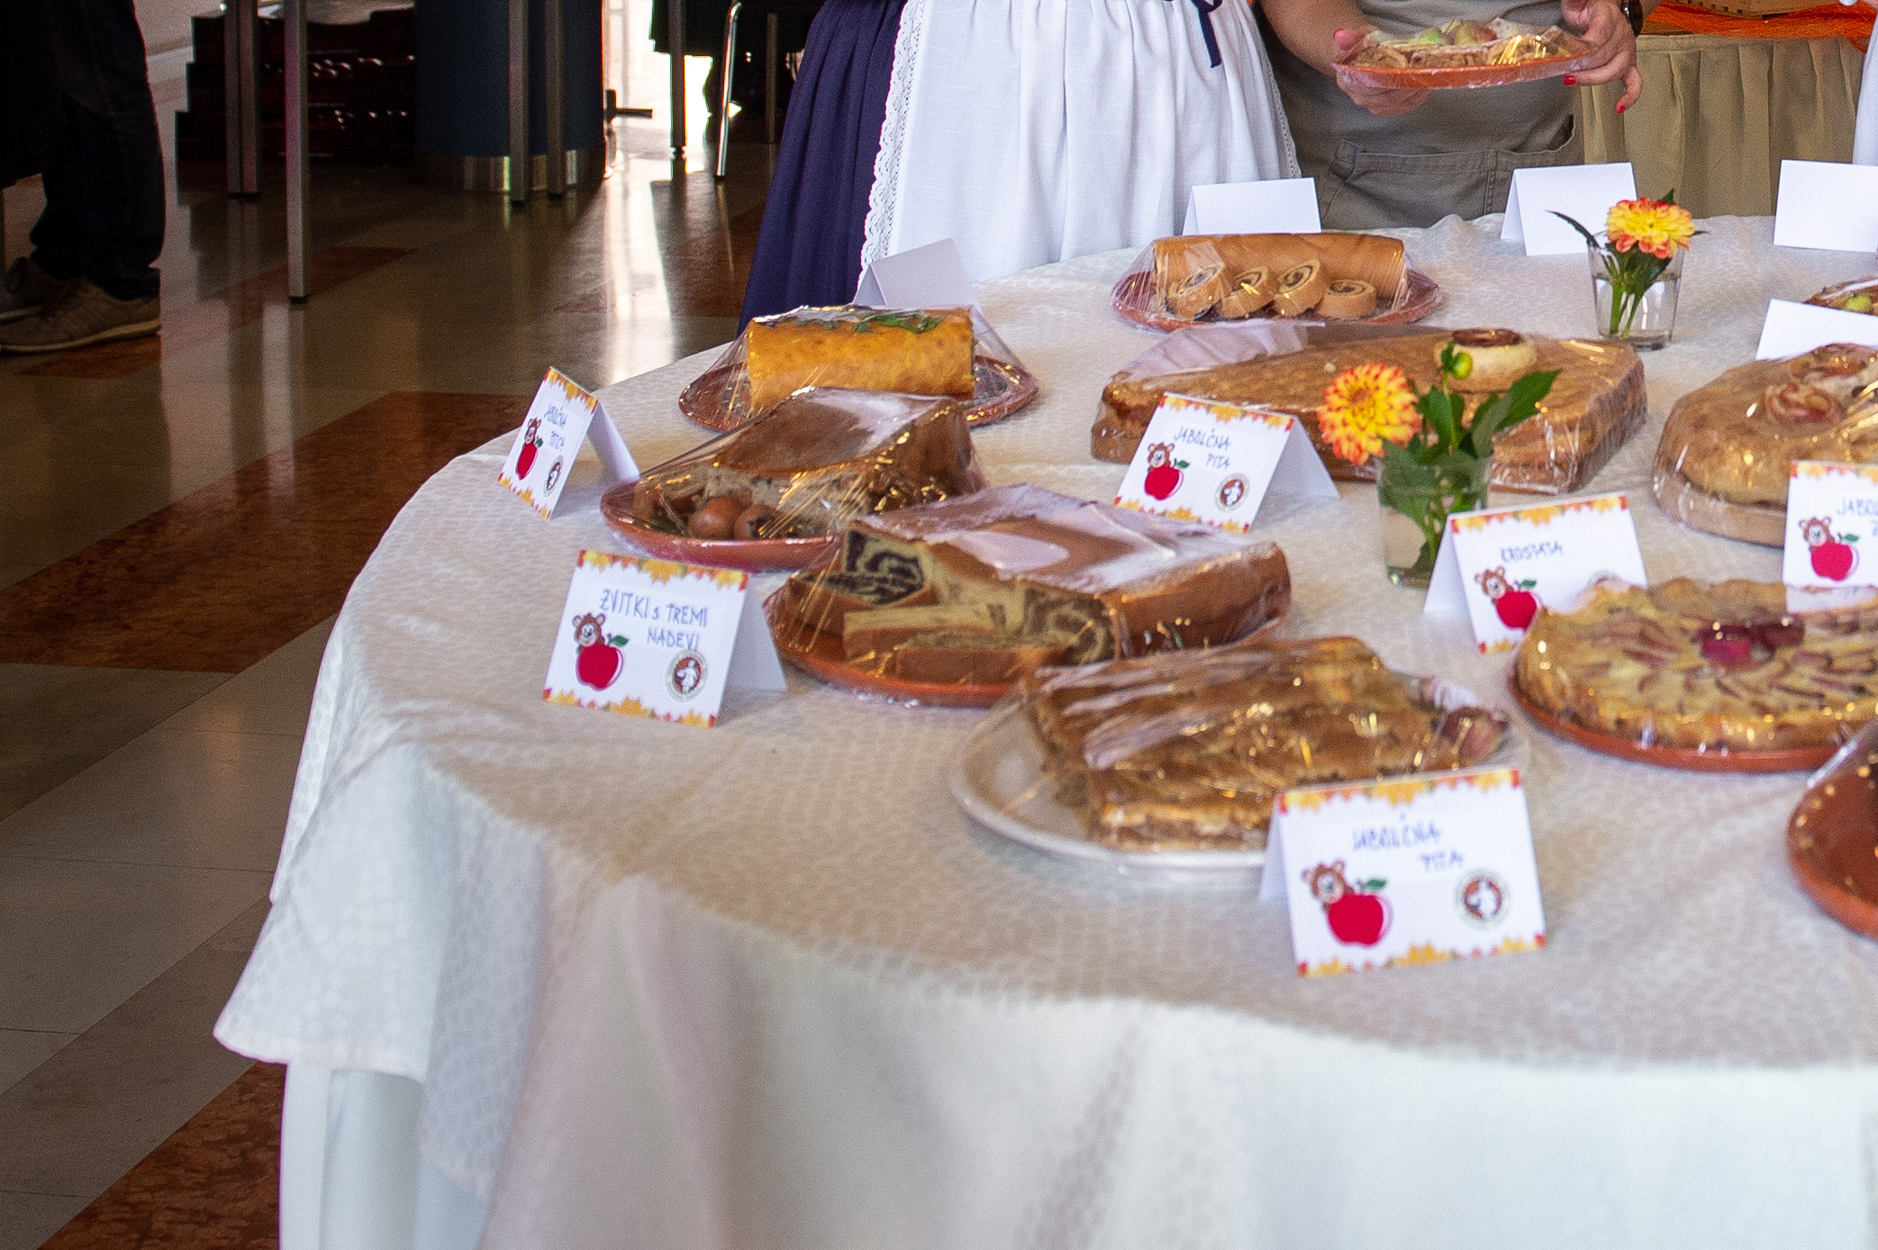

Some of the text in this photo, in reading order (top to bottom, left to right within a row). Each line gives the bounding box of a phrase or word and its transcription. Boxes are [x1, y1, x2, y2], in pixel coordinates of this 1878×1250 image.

[1173, 426, 1231, 450] JABOLČNA
[1206, 452, 1231, 470] PITA
[600, 589, 649, 619] ZVITKI
[666, 602, 708, 627] TREMI
[647, 627, 699, 651] NADEVI
[1353, 811, 1441, 851] JABOLČNA
[1420, 850, 1463, 872] PITA
